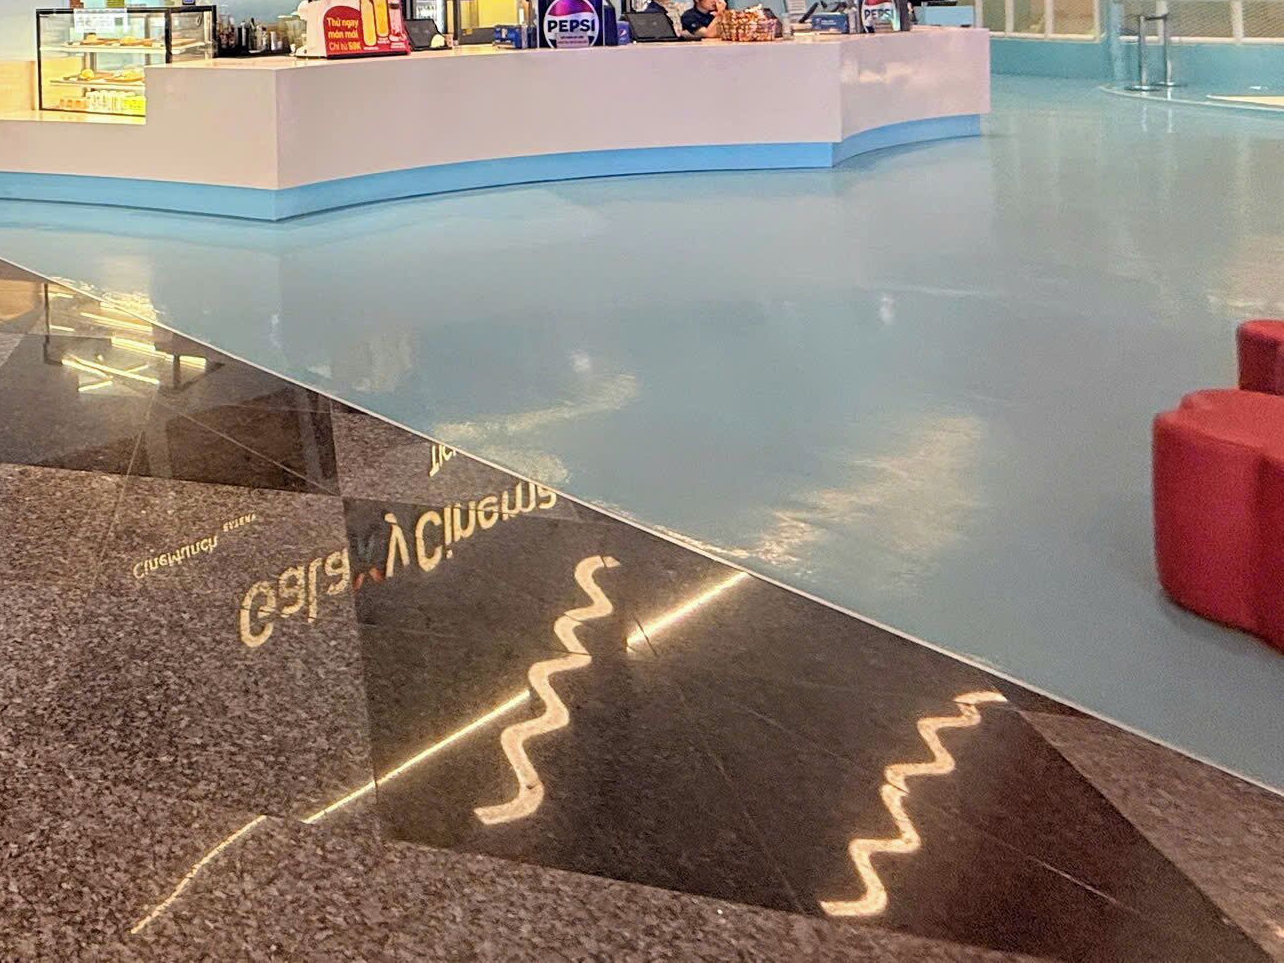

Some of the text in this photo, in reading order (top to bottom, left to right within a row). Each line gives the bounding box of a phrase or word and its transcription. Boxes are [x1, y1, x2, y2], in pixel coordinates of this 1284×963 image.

[864, 8, 894, 21] PEPSI
[342, 19, 359, 29] ngay
[547, 19, 596, 33] PEPSI
